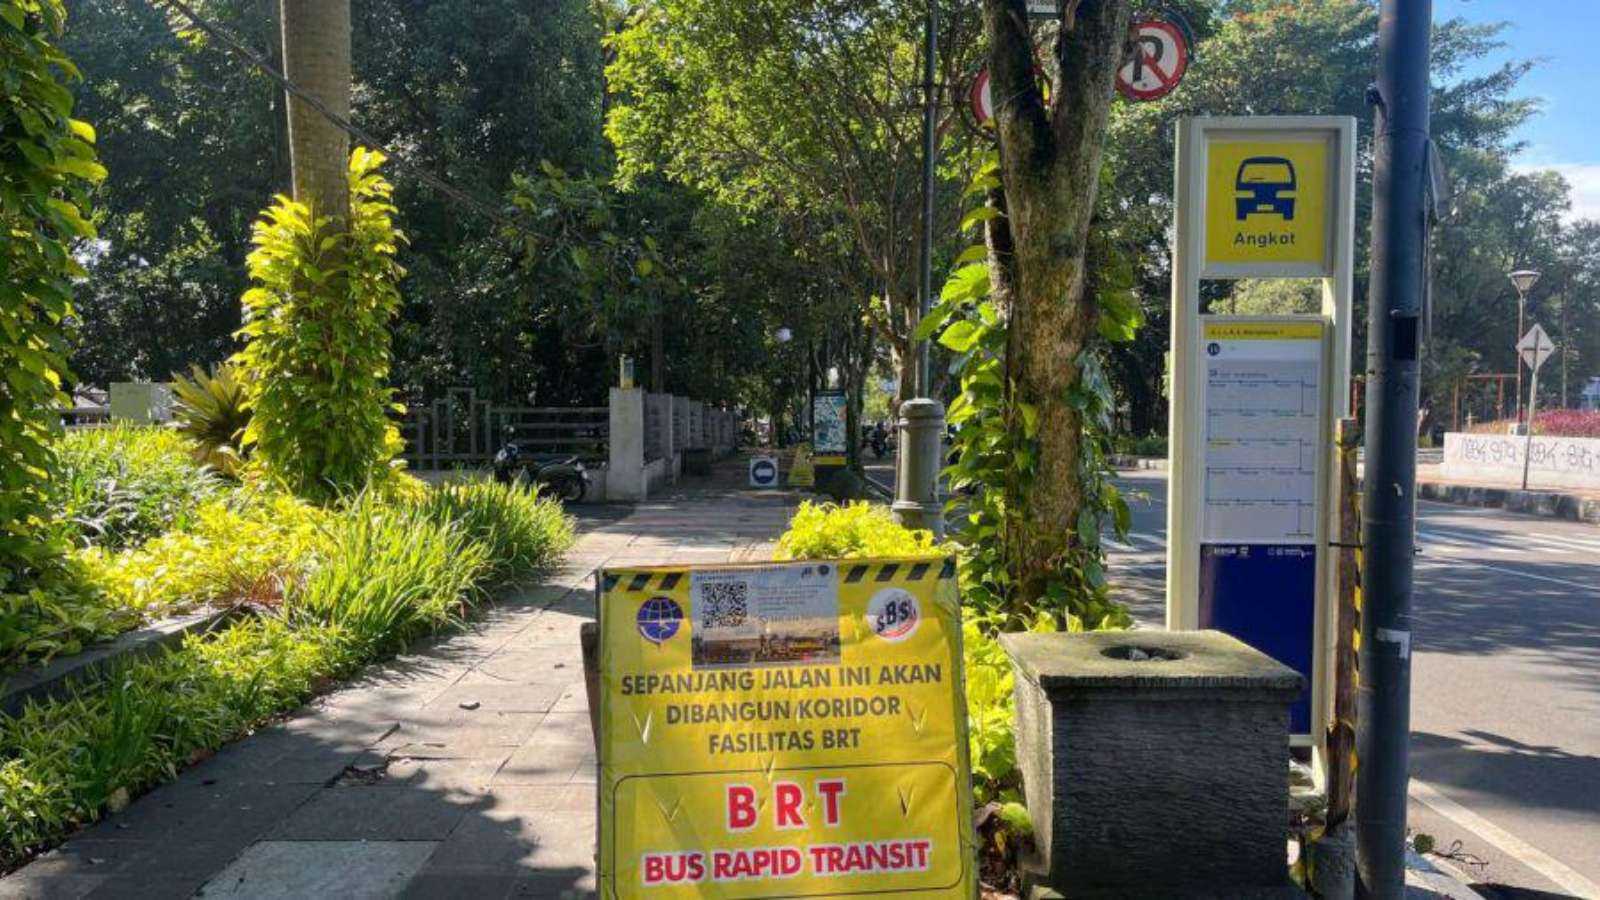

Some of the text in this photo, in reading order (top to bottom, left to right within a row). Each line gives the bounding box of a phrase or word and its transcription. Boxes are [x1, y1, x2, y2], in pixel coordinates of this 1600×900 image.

[1234, 232, 1295, 248] Angkot
[621, 663, 941, 695] SEPANJANG JALAN INI AKAN
[665, 696, 901, 725] DIBANGUN KORIDOR
[708, 728, 860, 754] FASILITAS BRT
[644, 841, 930, 882] BUS RAPID TRANSIT
